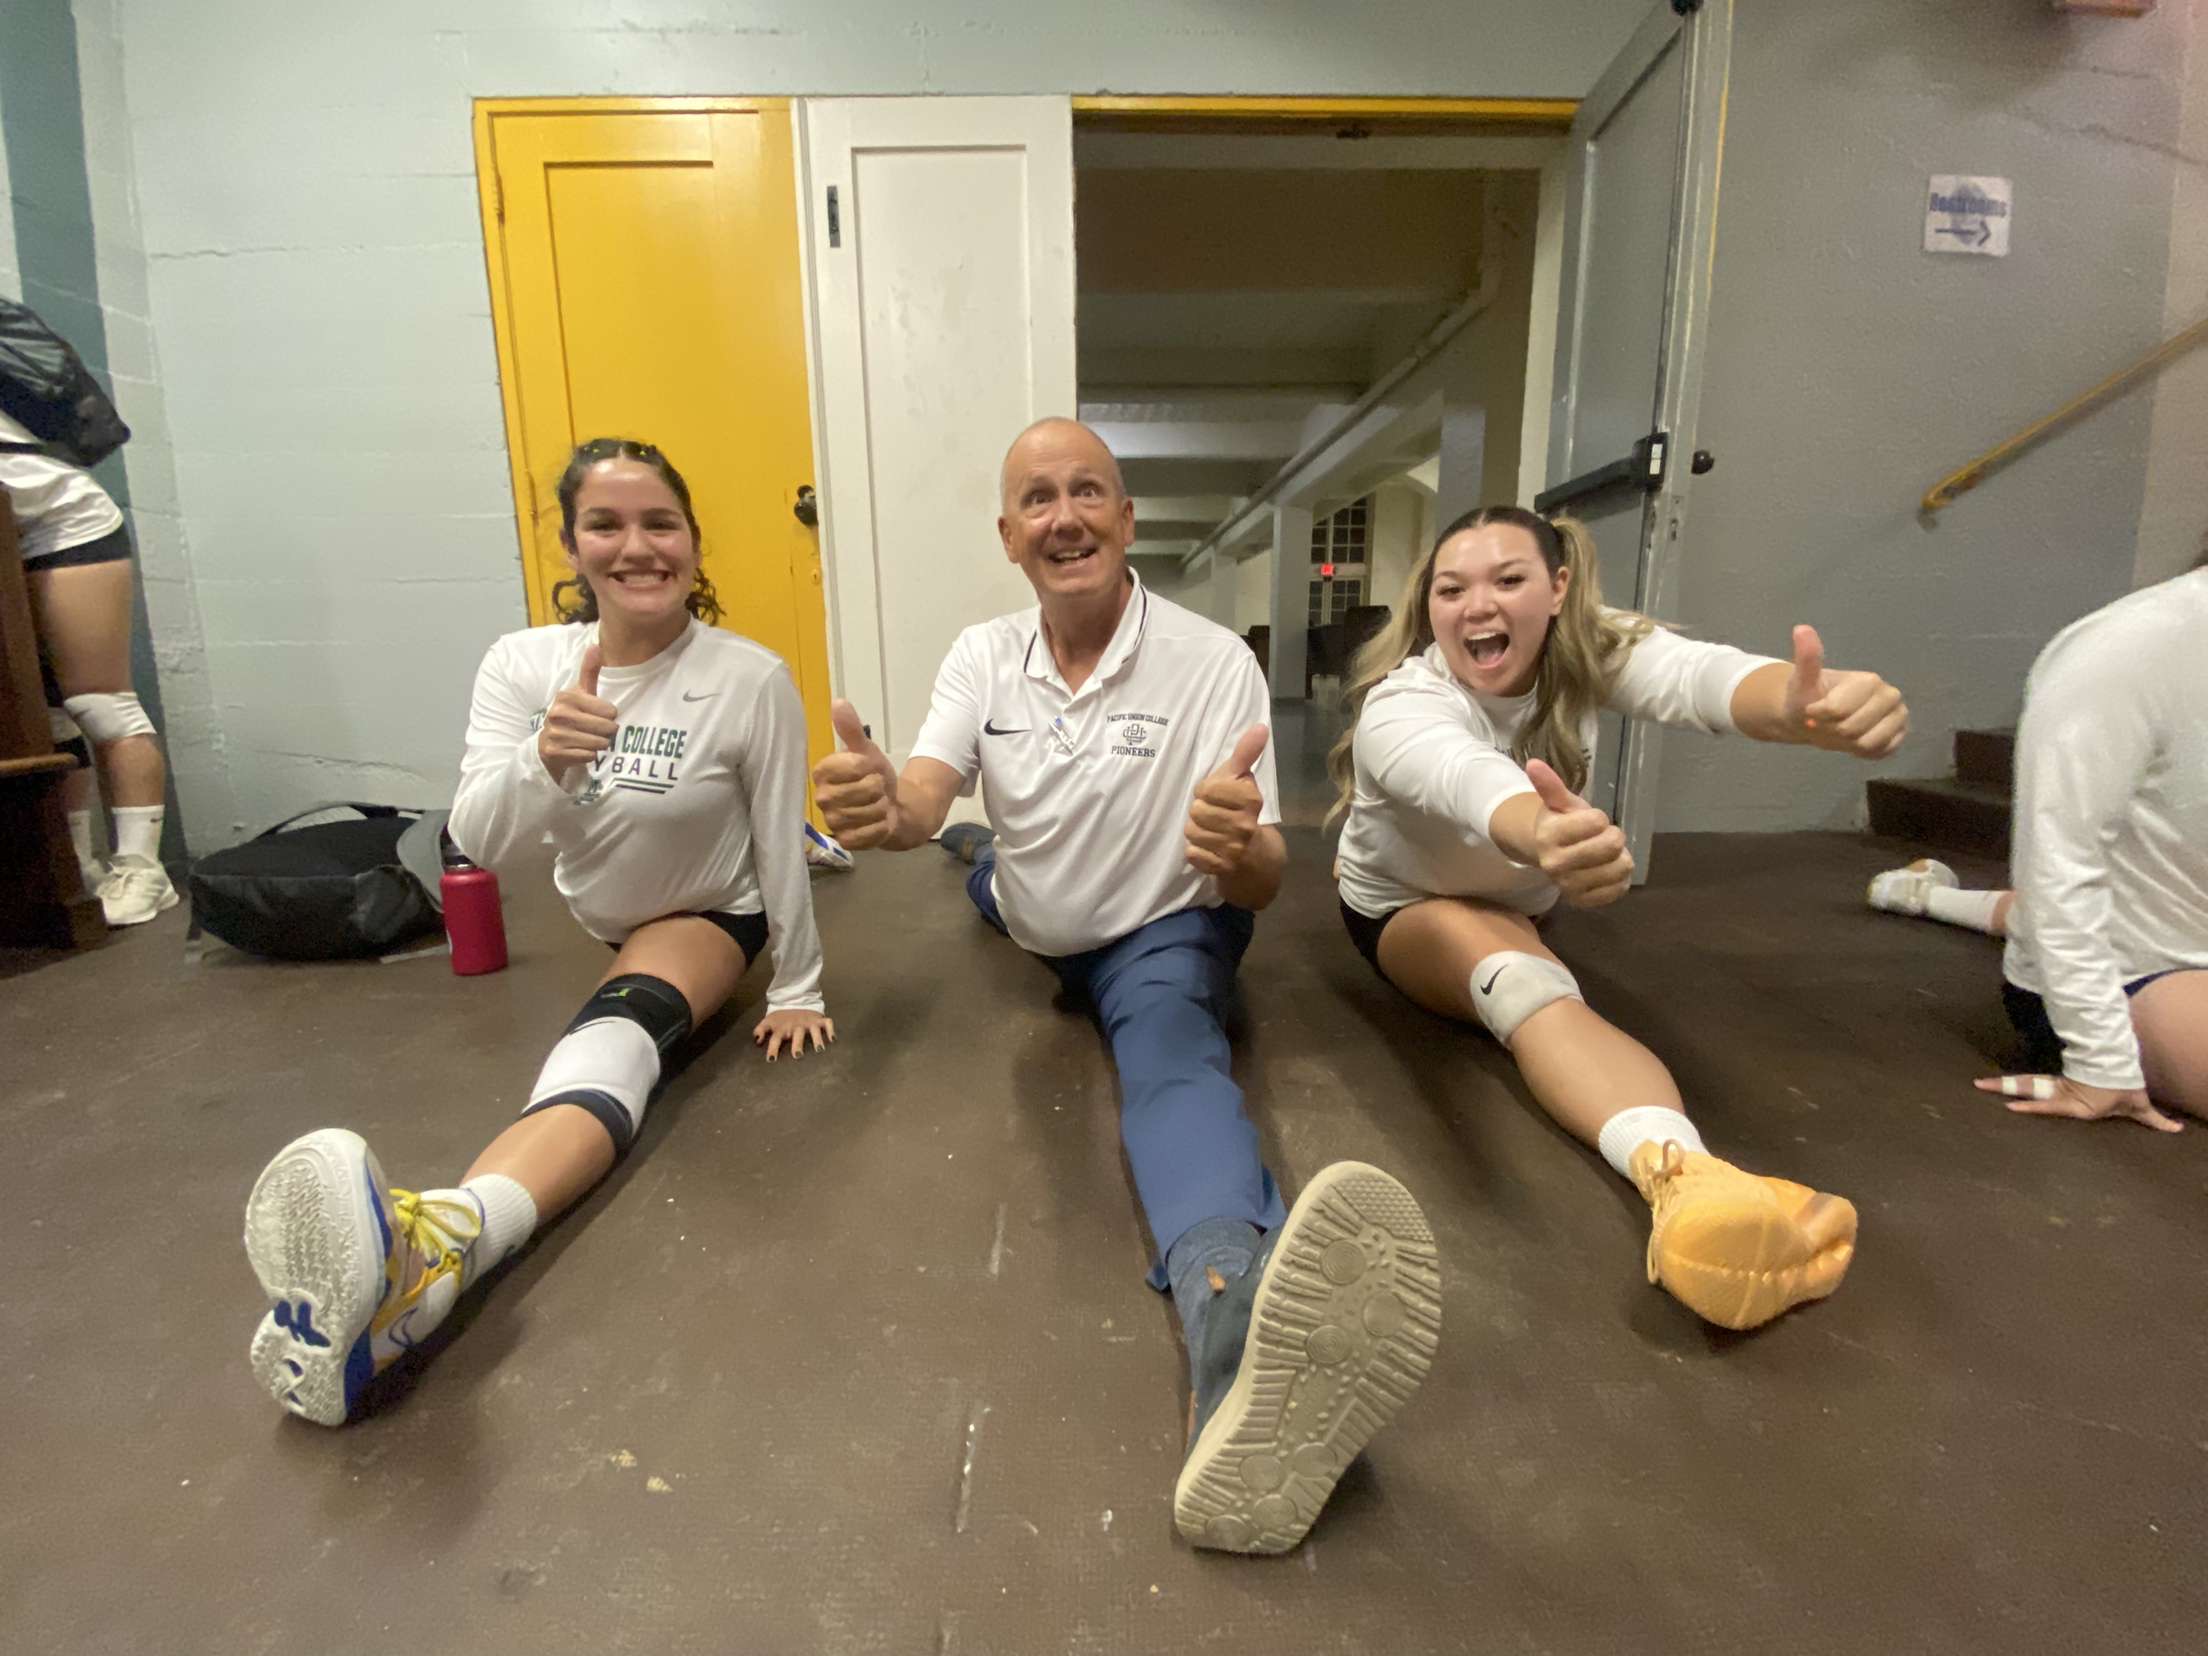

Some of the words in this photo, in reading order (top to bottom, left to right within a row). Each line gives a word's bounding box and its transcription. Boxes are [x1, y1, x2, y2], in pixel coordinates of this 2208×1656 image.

[621, 725, 687, 759] COLLEGE
[1111, 745, 1156, 758] PIONEERS
[595, 754, 678, 781] YBALL
